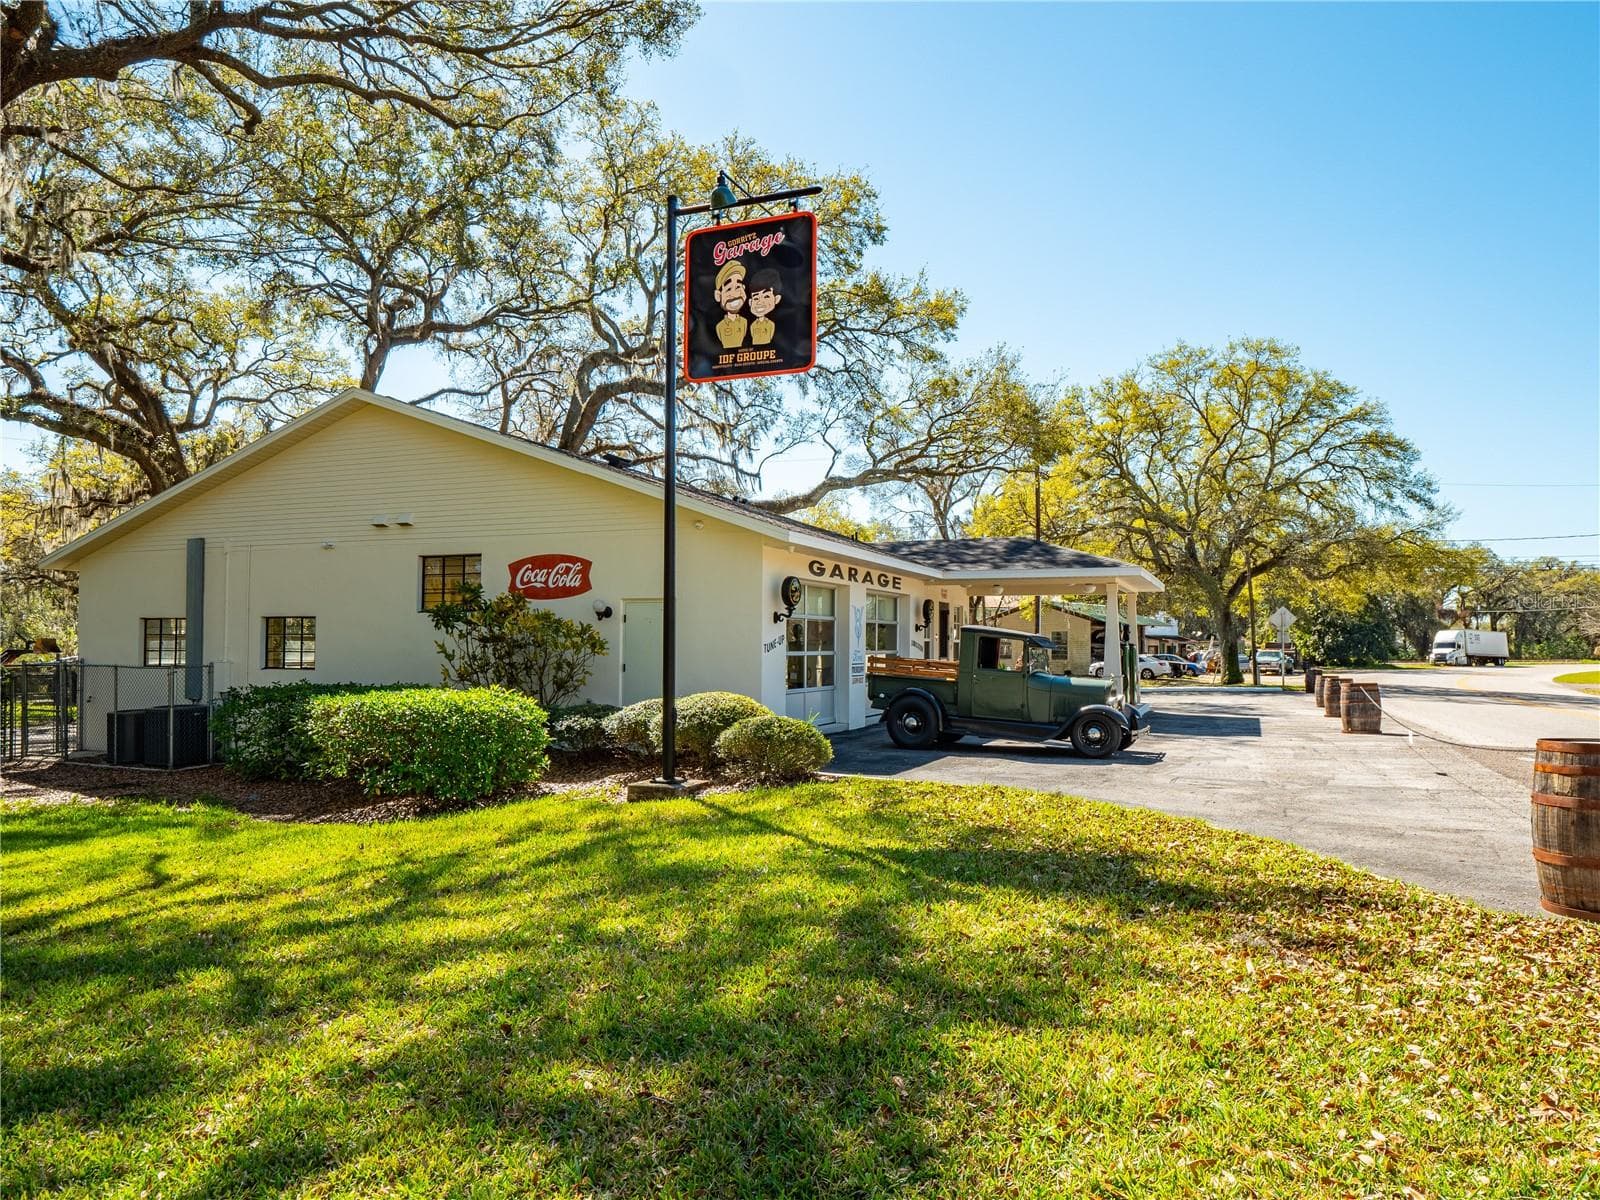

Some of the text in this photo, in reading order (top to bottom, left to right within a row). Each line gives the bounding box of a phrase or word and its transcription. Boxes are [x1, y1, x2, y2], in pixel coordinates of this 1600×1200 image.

[713, 231, 785, 266] Garage
[719, 353, 735, 364] IDF
[737, 350, 776, 362] GROUPE
[515, 562, 583, 589] Coca-Cola
[808, 559, 902, 590] GARAGE
[763, 634, 785, 654] TUNE-UP
